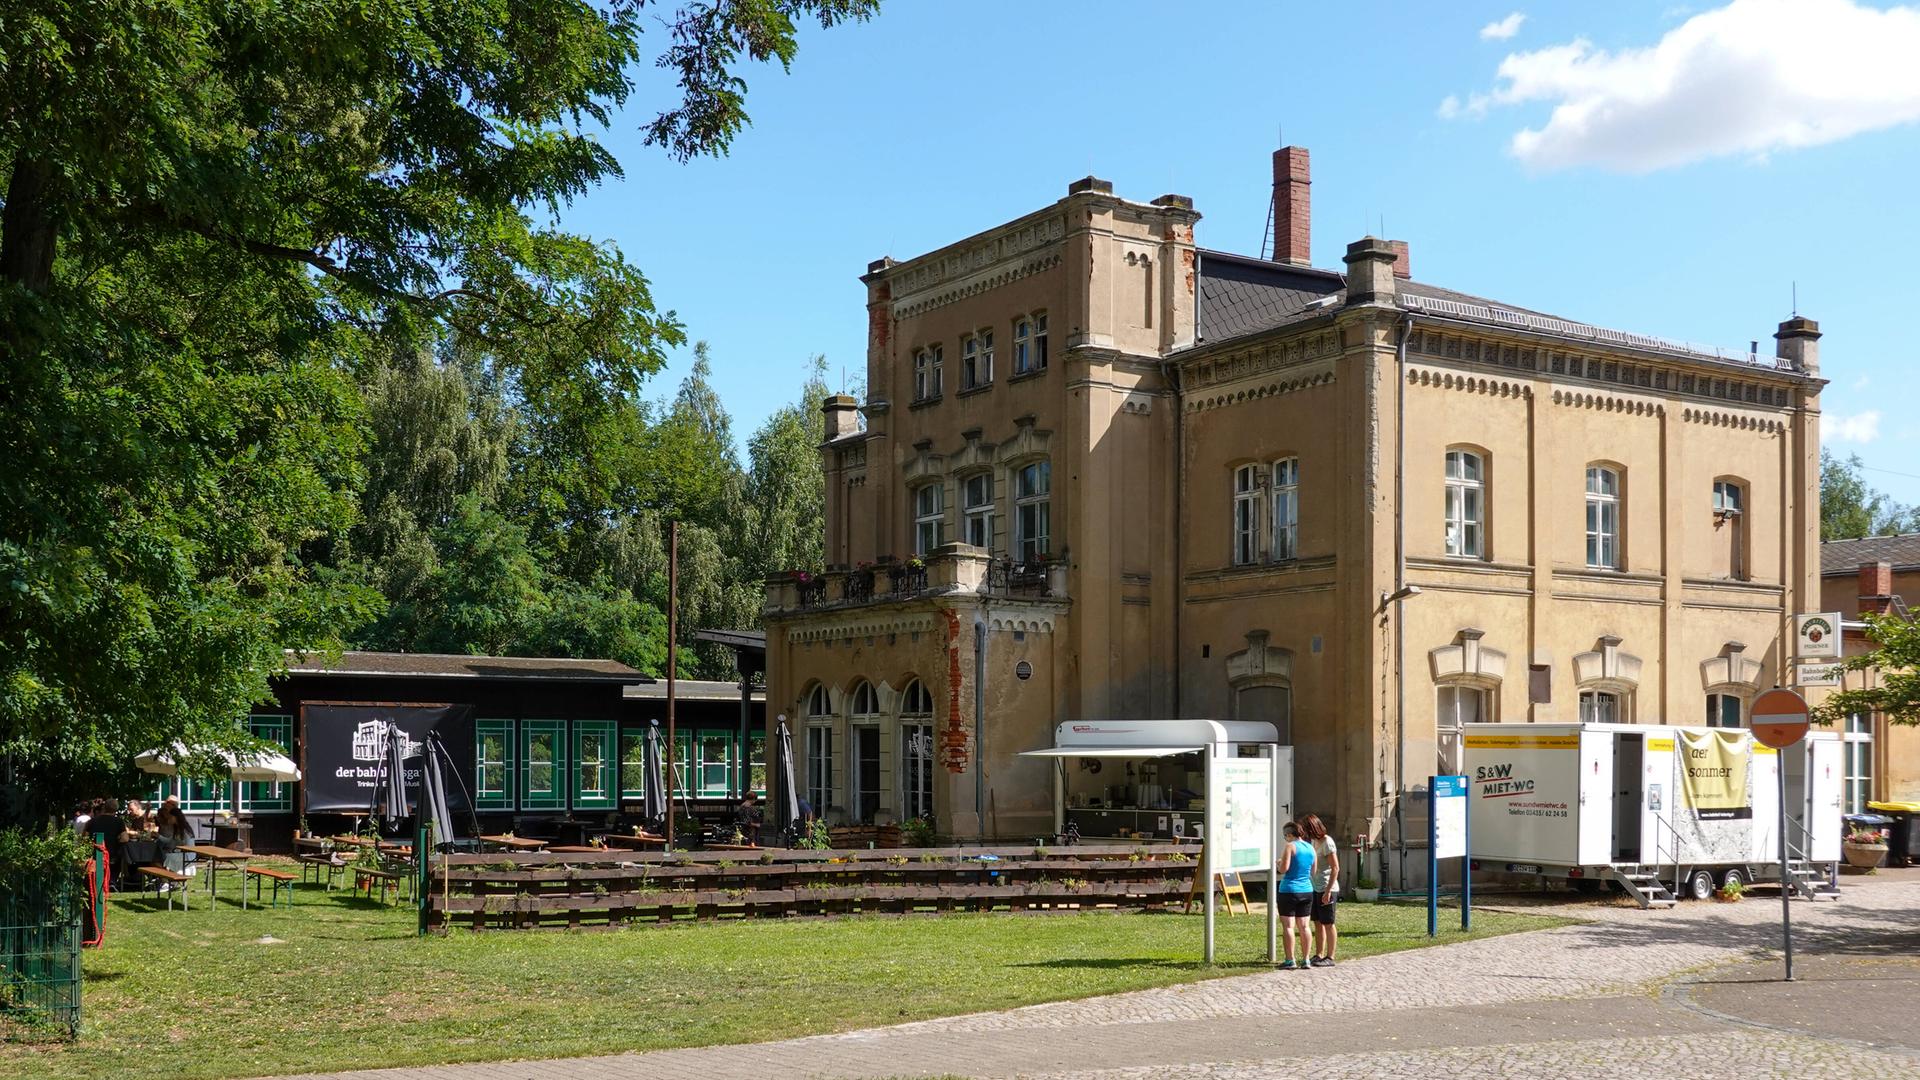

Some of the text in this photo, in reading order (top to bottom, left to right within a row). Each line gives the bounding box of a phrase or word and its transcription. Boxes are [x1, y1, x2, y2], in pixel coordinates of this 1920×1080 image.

[335, 766, 355, 778] der
[1477, 763, 1513, 779] S&W
[1483, 780, 1535, 795] MIET-WC
